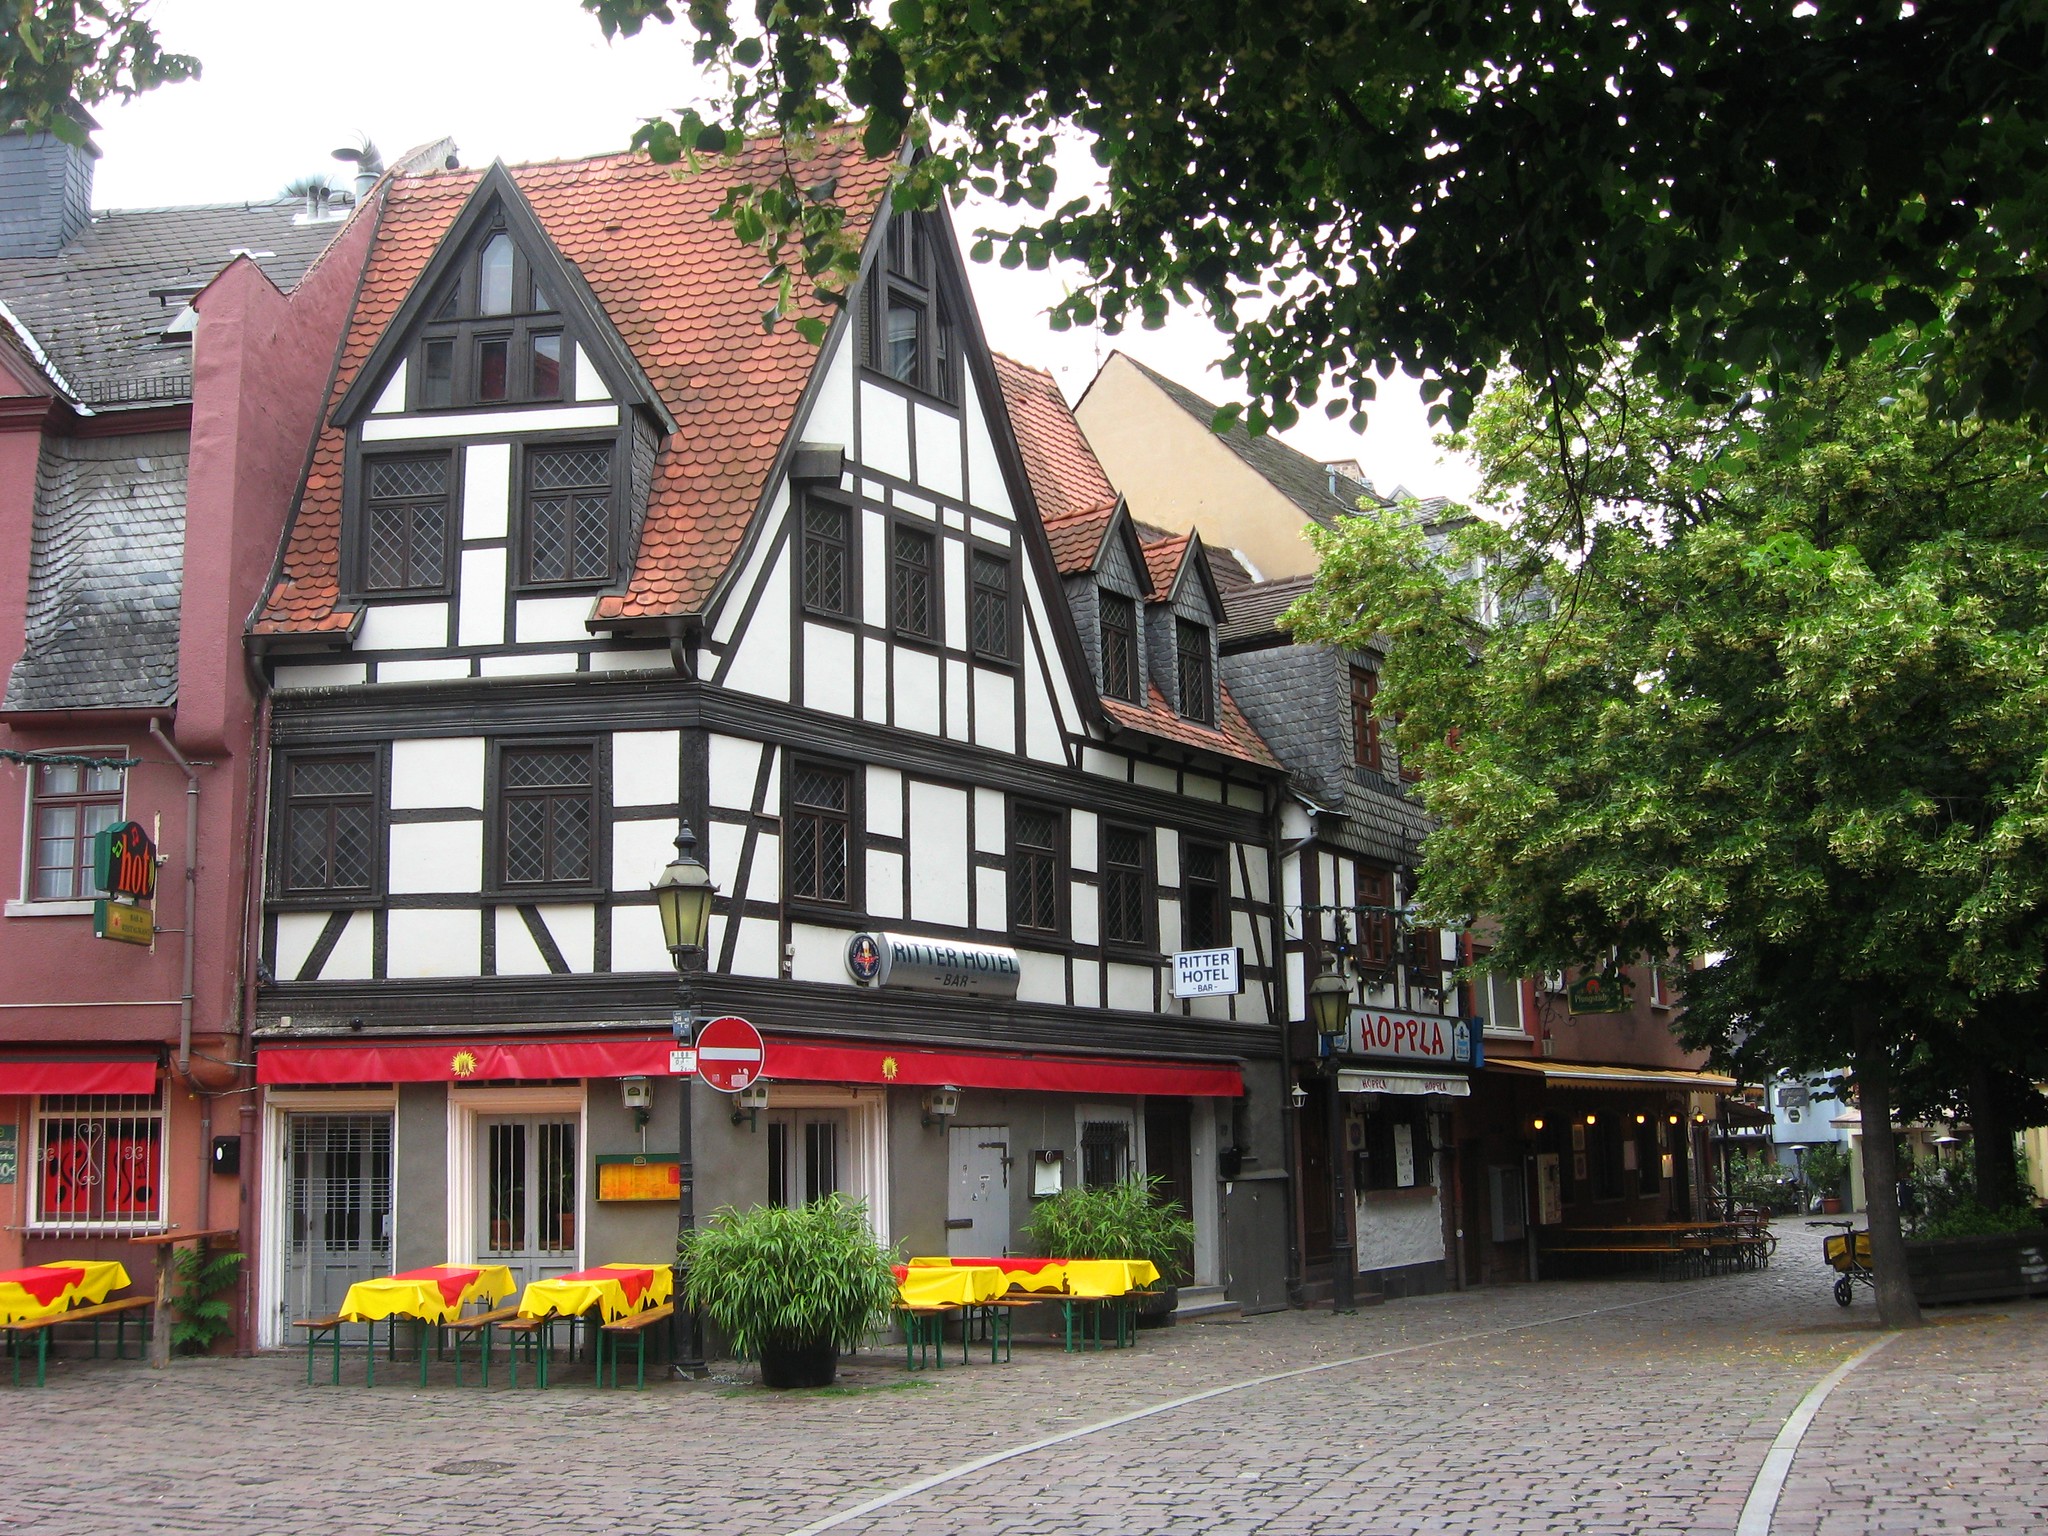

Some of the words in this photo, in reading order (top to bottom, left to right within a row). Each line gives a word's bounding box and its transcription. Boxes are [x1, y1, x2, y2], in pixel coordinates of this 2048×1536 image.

[118, 834, 149, 895] hot
[893, 940, 958, 968] RITTER
[962, 949, 1018, 975] HOTEL
[1179, 953, 1230, 969] RITTER
[943, 973, 968, 988] BAR
[1182, 968, 1229, 983] HOTEL
[1360, 1013, 1445, 1056] HOPPLA
[1361, 1079, 1387, 1090] HOPPLA
